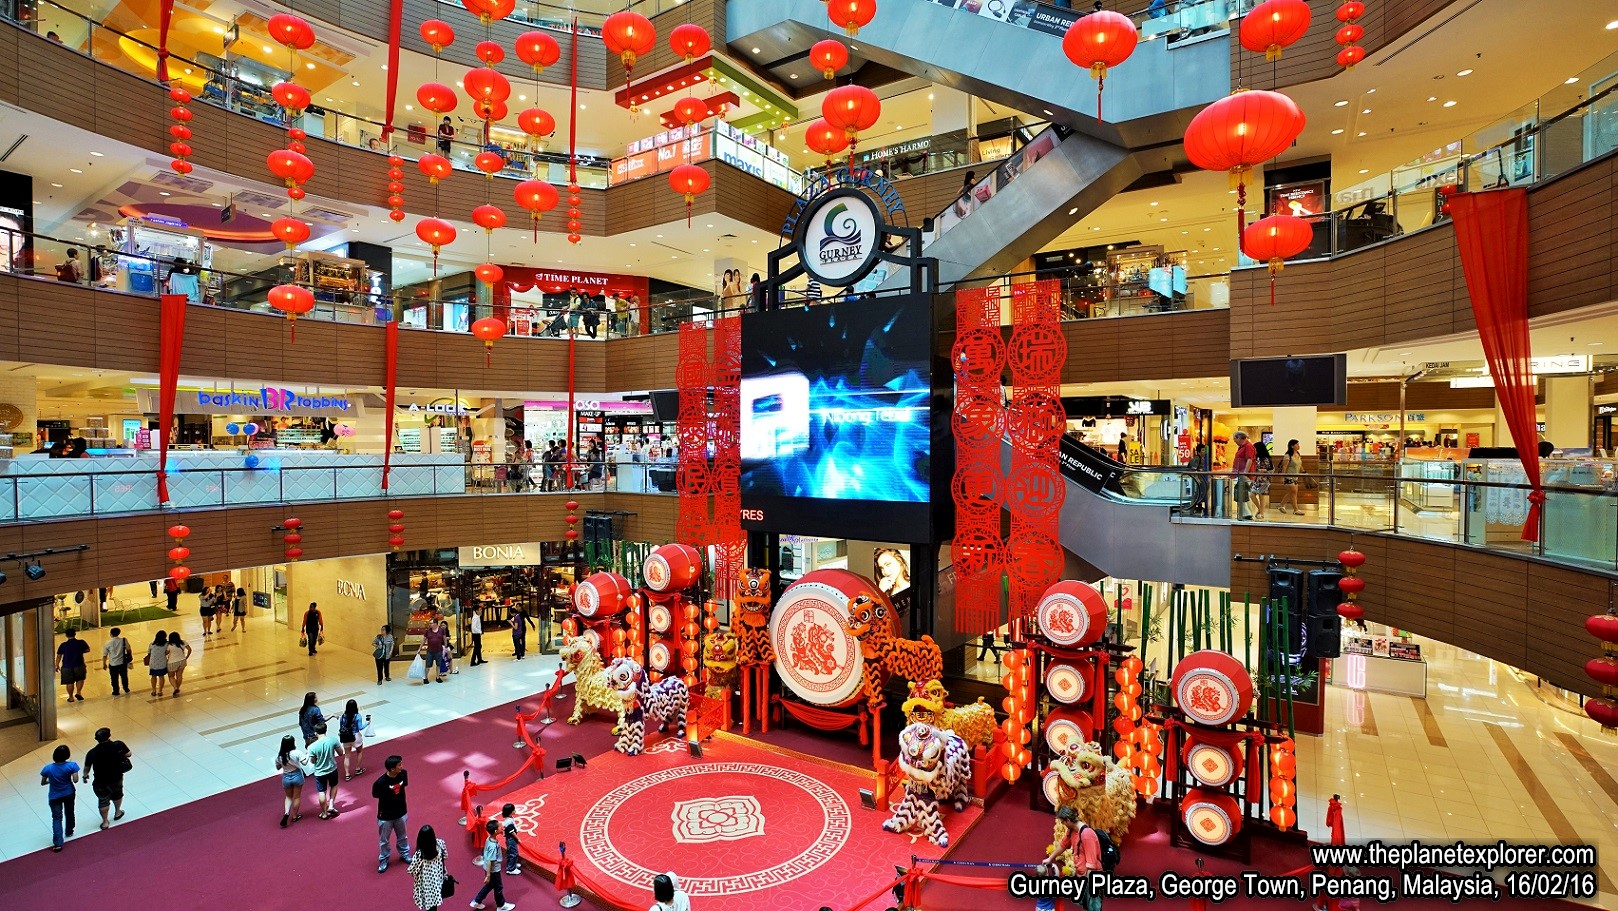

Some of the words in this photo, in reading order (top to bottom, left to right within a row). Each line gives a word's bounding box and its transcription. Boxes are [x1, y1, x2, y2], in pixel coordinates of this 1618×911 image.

[1036, 12, 1061, 25] URBAN
[658, 144, 677, 162] No.1
[871, 145, 898, 160] HOME'S
[981, 147, 1001, 156] Living
[723, 151, 762, 178] maxis
[836, 167, 906, 215] GURNEY
[819, 244, 863, 260] GURNEY
[544, 272, 570, 284] TIME
[571, 275, 609, 287] PLANET
[197, 391, 259, 410] baskin
[259, 387, 296, 412] BR
[296, 397, 349, 412] robbins
[823, 410, 871, 425] Nibong
[1344, 412, 1402, 422] PARKSON
[1178, 449, 1191, 459] 50
[1068, 455, 1103, 480] REPUBLIC
[740, 509, 764, 521] RES
[473, 544, 526, 560] BONIA
[336, 579, 367, 601] BONIA
